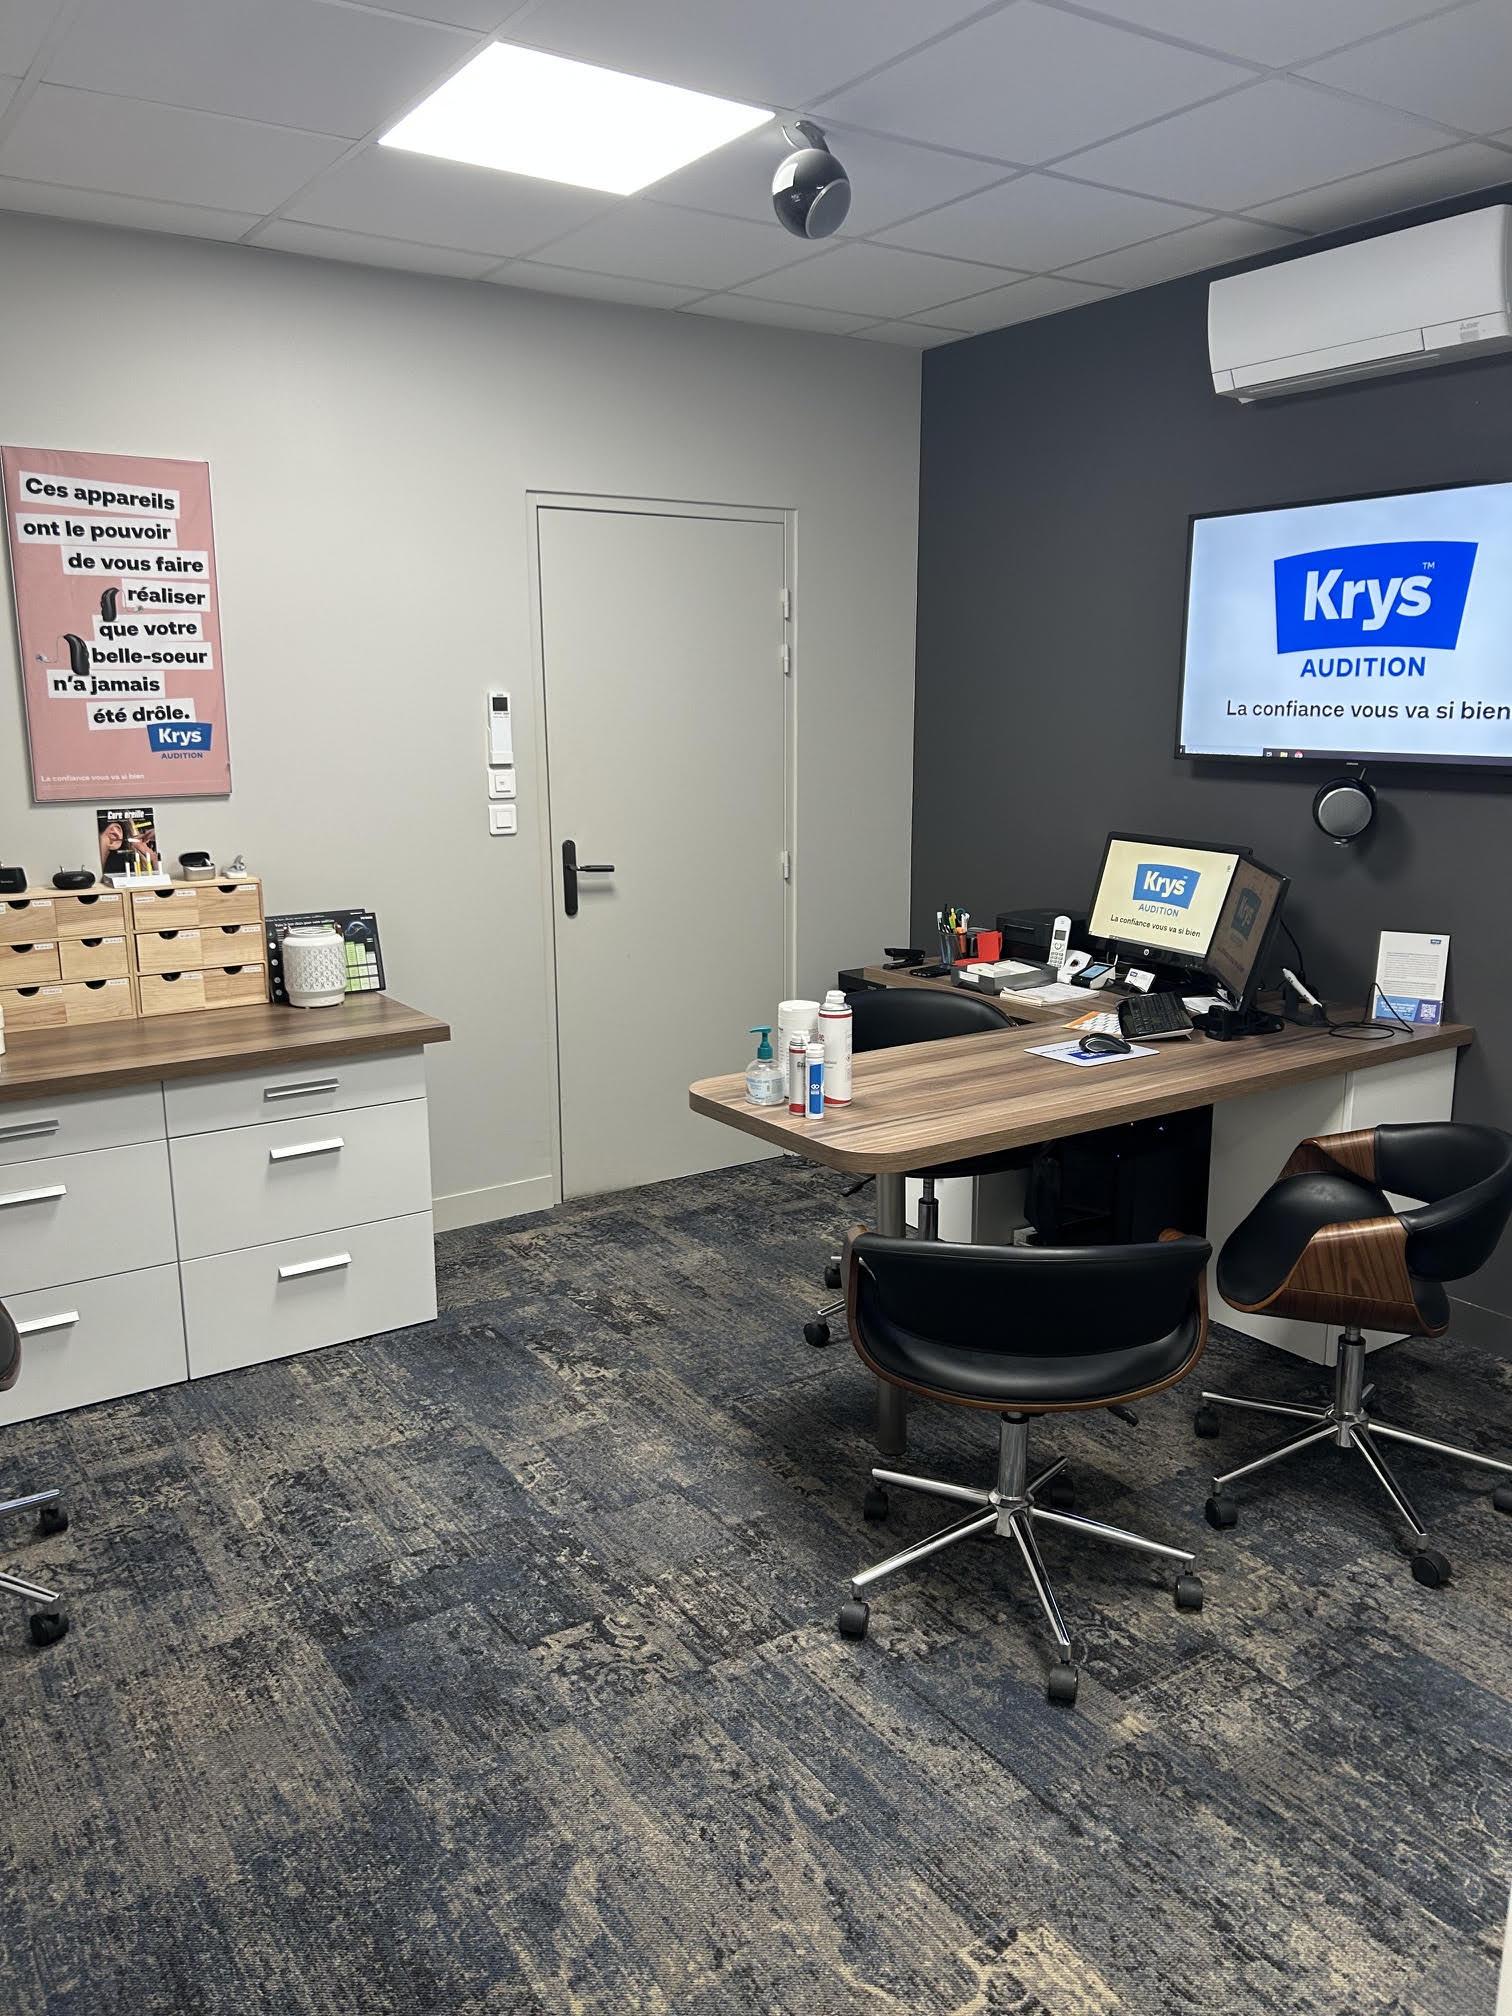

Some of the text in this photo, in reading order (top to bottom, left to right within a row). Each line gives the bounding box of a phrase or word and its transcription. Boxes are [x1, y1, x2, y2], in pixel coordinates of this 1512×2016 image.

[25, 477, 175, 511] Ces appareils
[23, 520, 172, 542] ont le pouvoir
[68, 552, 204, 573] de vous faire
[128, 586, 206, 605] réaliser
[1303, 568, 1433, 632] Krys
[99, 621, 197, 641] que votre
[92, 647, 208, 664] belle-soeur
[1300, 656, 1426, 678] AUDITION
[53, 675, 160, 696] n'a jamais
[93, 705, 190, 724] été drôle.
[1226, 700, 1511, 720] La confiance vous va si bien
[158, 727, 202, 746] Krys
[161, 752, 203, 760] AUDITION
[52, 774, 90, 782] confiance
[1143, 870, 1186, 898] Krys
[1138, 903, 1179, 917] AUDITION
[1110, 914, 1201, 938] La confiance vous va si bien
